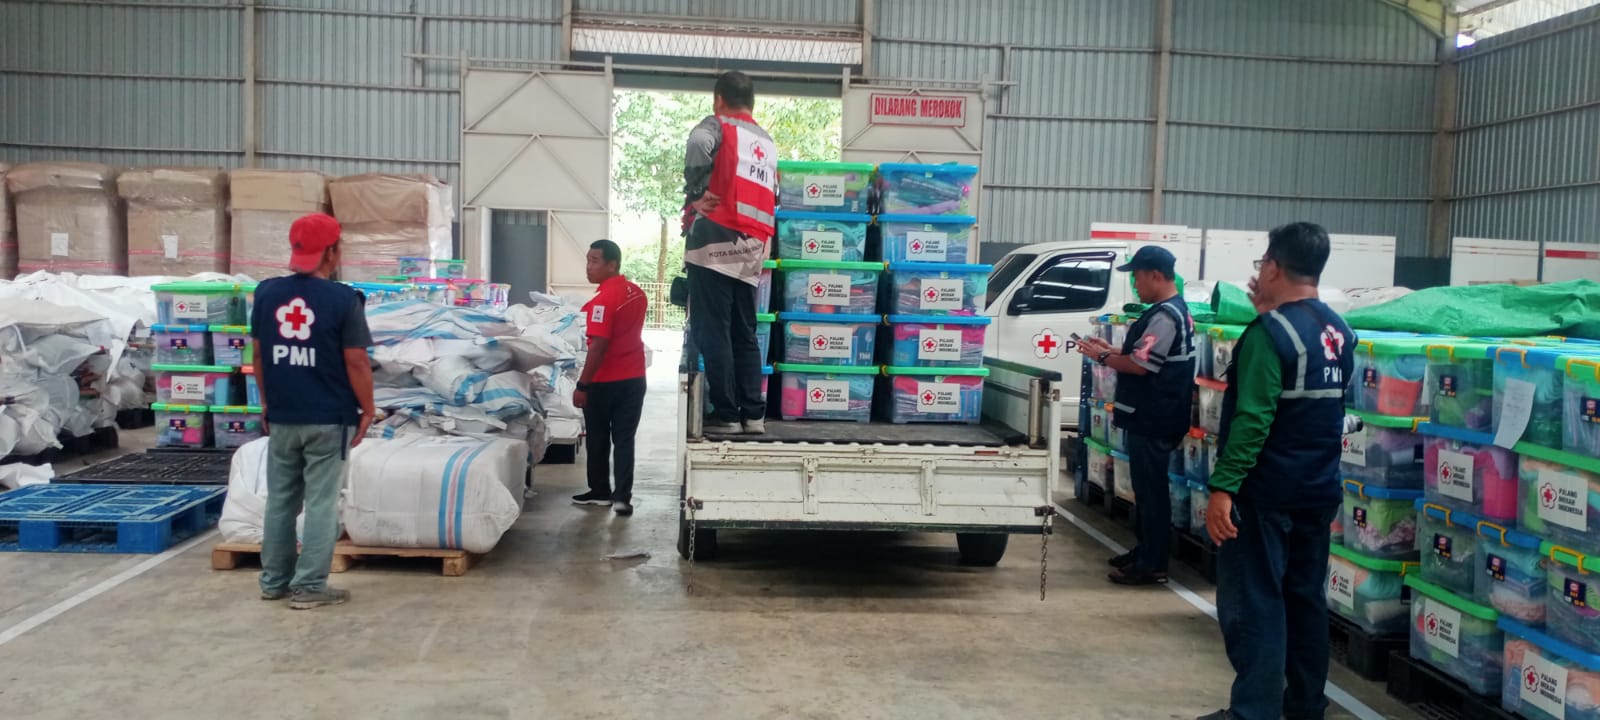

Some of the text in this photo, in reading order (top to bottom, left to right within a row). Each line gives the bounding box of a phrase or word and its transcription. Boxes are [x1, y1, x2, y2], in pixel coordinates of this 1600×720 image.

[874, 97, 962, 118] DILARANG MEROKOK
[750, 166, 768, 183] PMI
[272, 344, 316, 367] PMI
